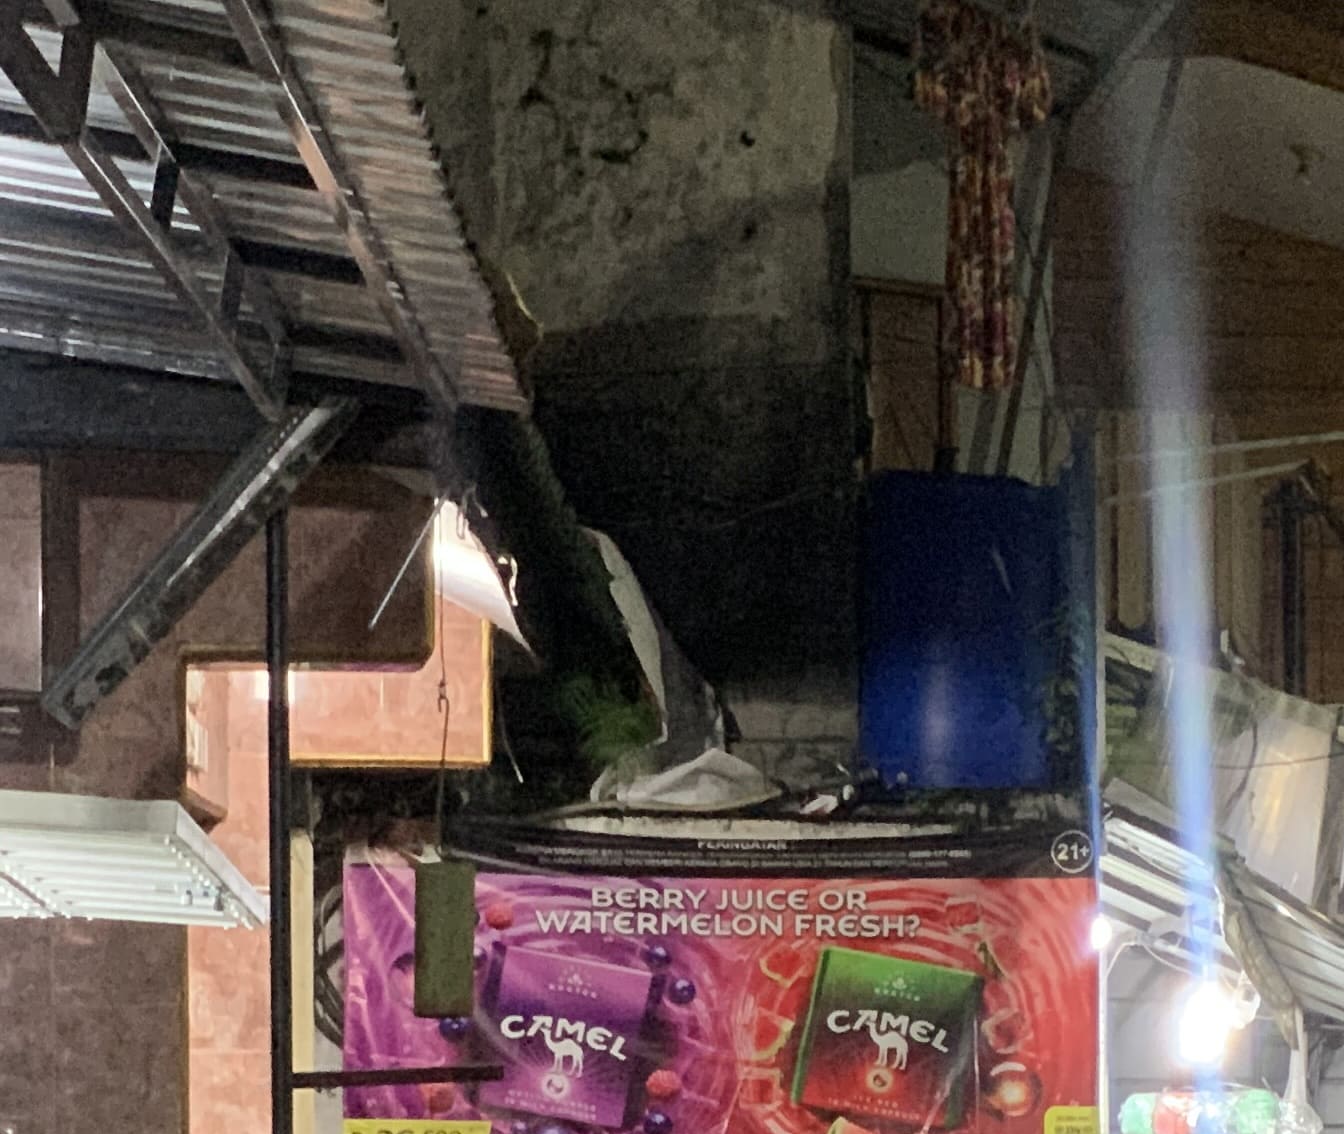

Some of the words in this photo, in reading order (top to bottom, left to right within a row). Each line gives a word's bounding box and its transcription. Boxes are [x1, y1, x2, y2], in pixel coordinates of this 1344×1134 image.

[1056, 842, 1091, 861] 21+
[591, 886, 707, 911] BERRY
[715, 888, 809, 912] JUICE
[818, 889, 867, 911] OR
[535, 909, 784, 937] WATERMELON
[795, 914, 921, 938] FRESH?
[500, 1014, 628, 1062] CAMEL
[826, 1009, 949, 1054] CAMEL
